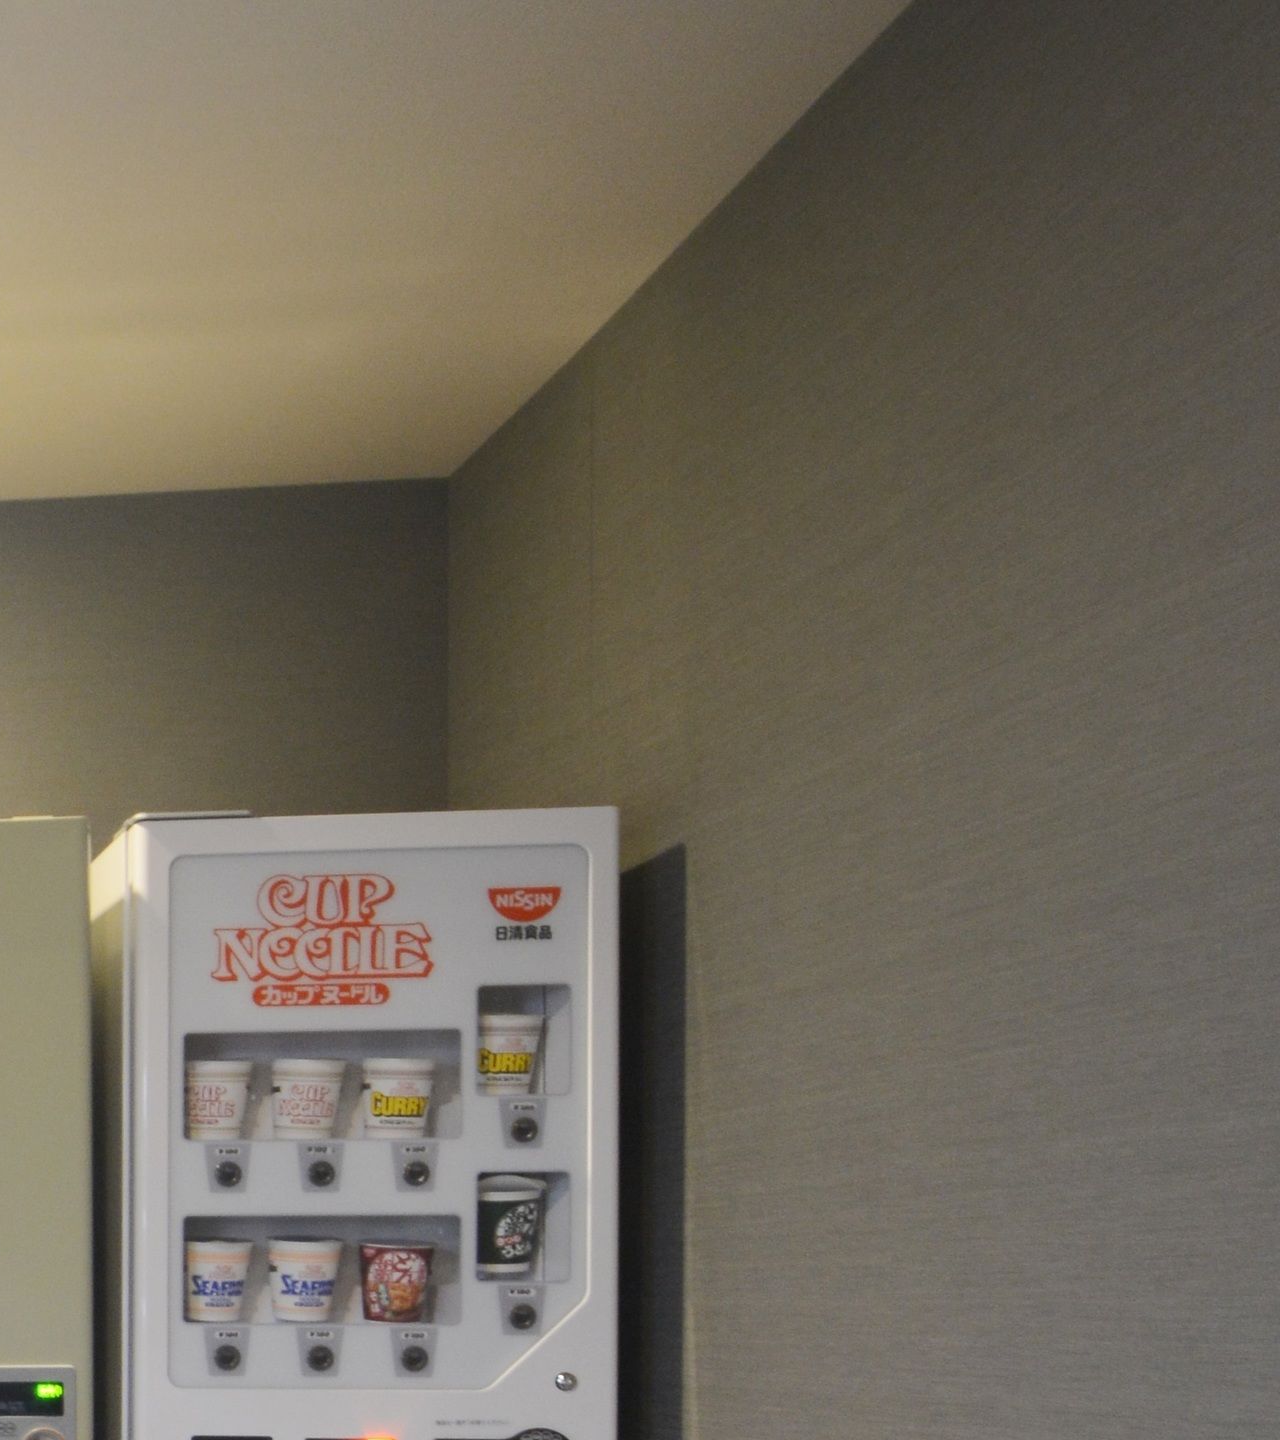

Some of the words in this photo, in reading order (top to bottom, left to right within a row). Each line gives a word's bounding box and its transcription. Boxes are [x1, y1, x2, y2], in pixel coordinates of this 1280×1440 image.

[257, 874, 395, 928] CUP
[494, 893, 554, 908] NISSIN
[494, 925, 553, 941] 日清食品
[370, 1091, 428, 1118] CURRY
